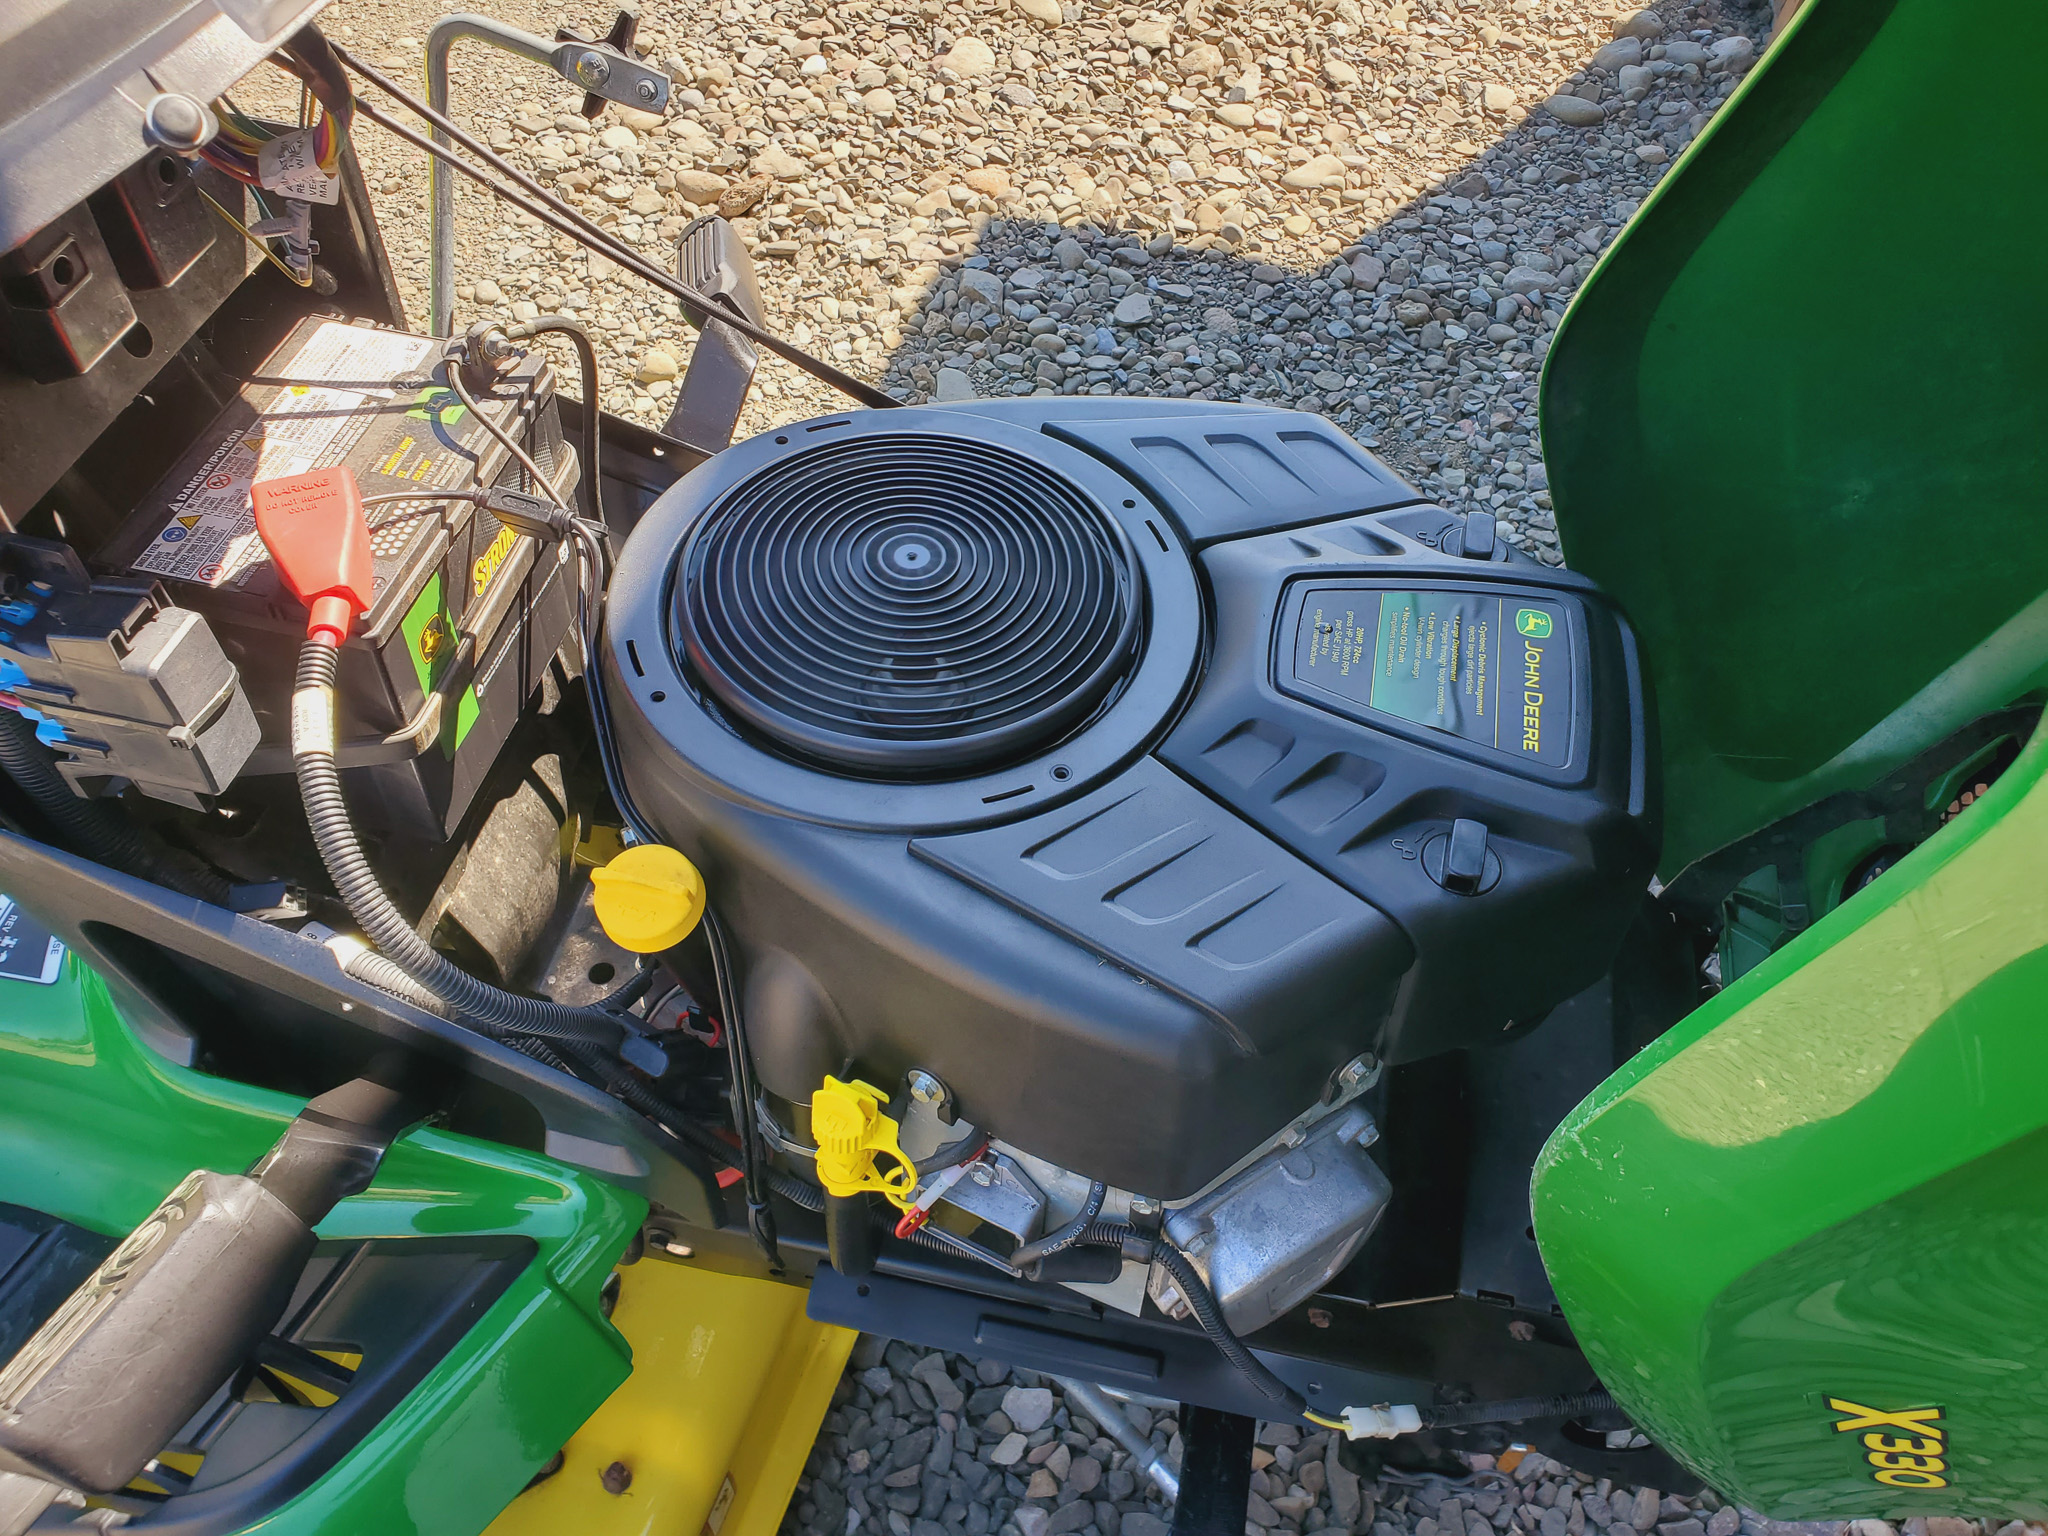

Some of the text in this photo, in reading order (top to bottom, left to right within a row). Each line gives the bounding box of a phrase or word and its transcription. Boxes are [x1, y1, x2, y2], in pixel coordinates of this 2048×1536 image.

[175, 427, 244, 500] DANGER/POISON
[379, 451, 402, 474] 6-MONTH
[410, 469, 425, 481] CCA
[267, 477, 330, 498] WARNING
[265, 489, 338, 510] DO NOT REMOVE
[288, 503, 317, 514] COVER
[208, 553, 220, 562] KEEP
[232, 522, 245, 534] REACH
[134, 552, 153, 567] SHIELD
[1345, 610, 1353, 626] gross
[1308, 608, 1323, 667] engine manufacturer
[1321, 632, 1330, 646] rated
[1330, 619, 1342, 662] per SAE J1940
[1345, 628, 1352, 637] HP
[1385, 611, 1398, 676] simplifies maintenance
[1398, 611, 1409, 662] No-tool Oil Drain
[1424, 616, 1435, 659] Low Vibration
[1466, 625, 1476, 642] ejects
[1342, 645, 1350, 660] 3600
[1352, 626, 1364, 663] 20HP, 724cc
[1413, 635, 1422, 657] cylinder
[1448, 620, 1460, 681] Large Displacement
[1465, 643, 1474, 658] large
[1340, 660, 1349, 675] RPM
[1411, 658, 1420, 678] design
[1436, 620, 1448, 714] charges through tough conditions
[1473, 625, 1488, 715] Cyclonic Debris Management
[1463, 669, 1474, 694] particles
[1522, 640, 1543, 753] JOHN DEERE
[2, 914, 18, 932] REV
[1041, 1243, 1059, 1256] SAE
[1822, 1393, 1952, 1488] X330
